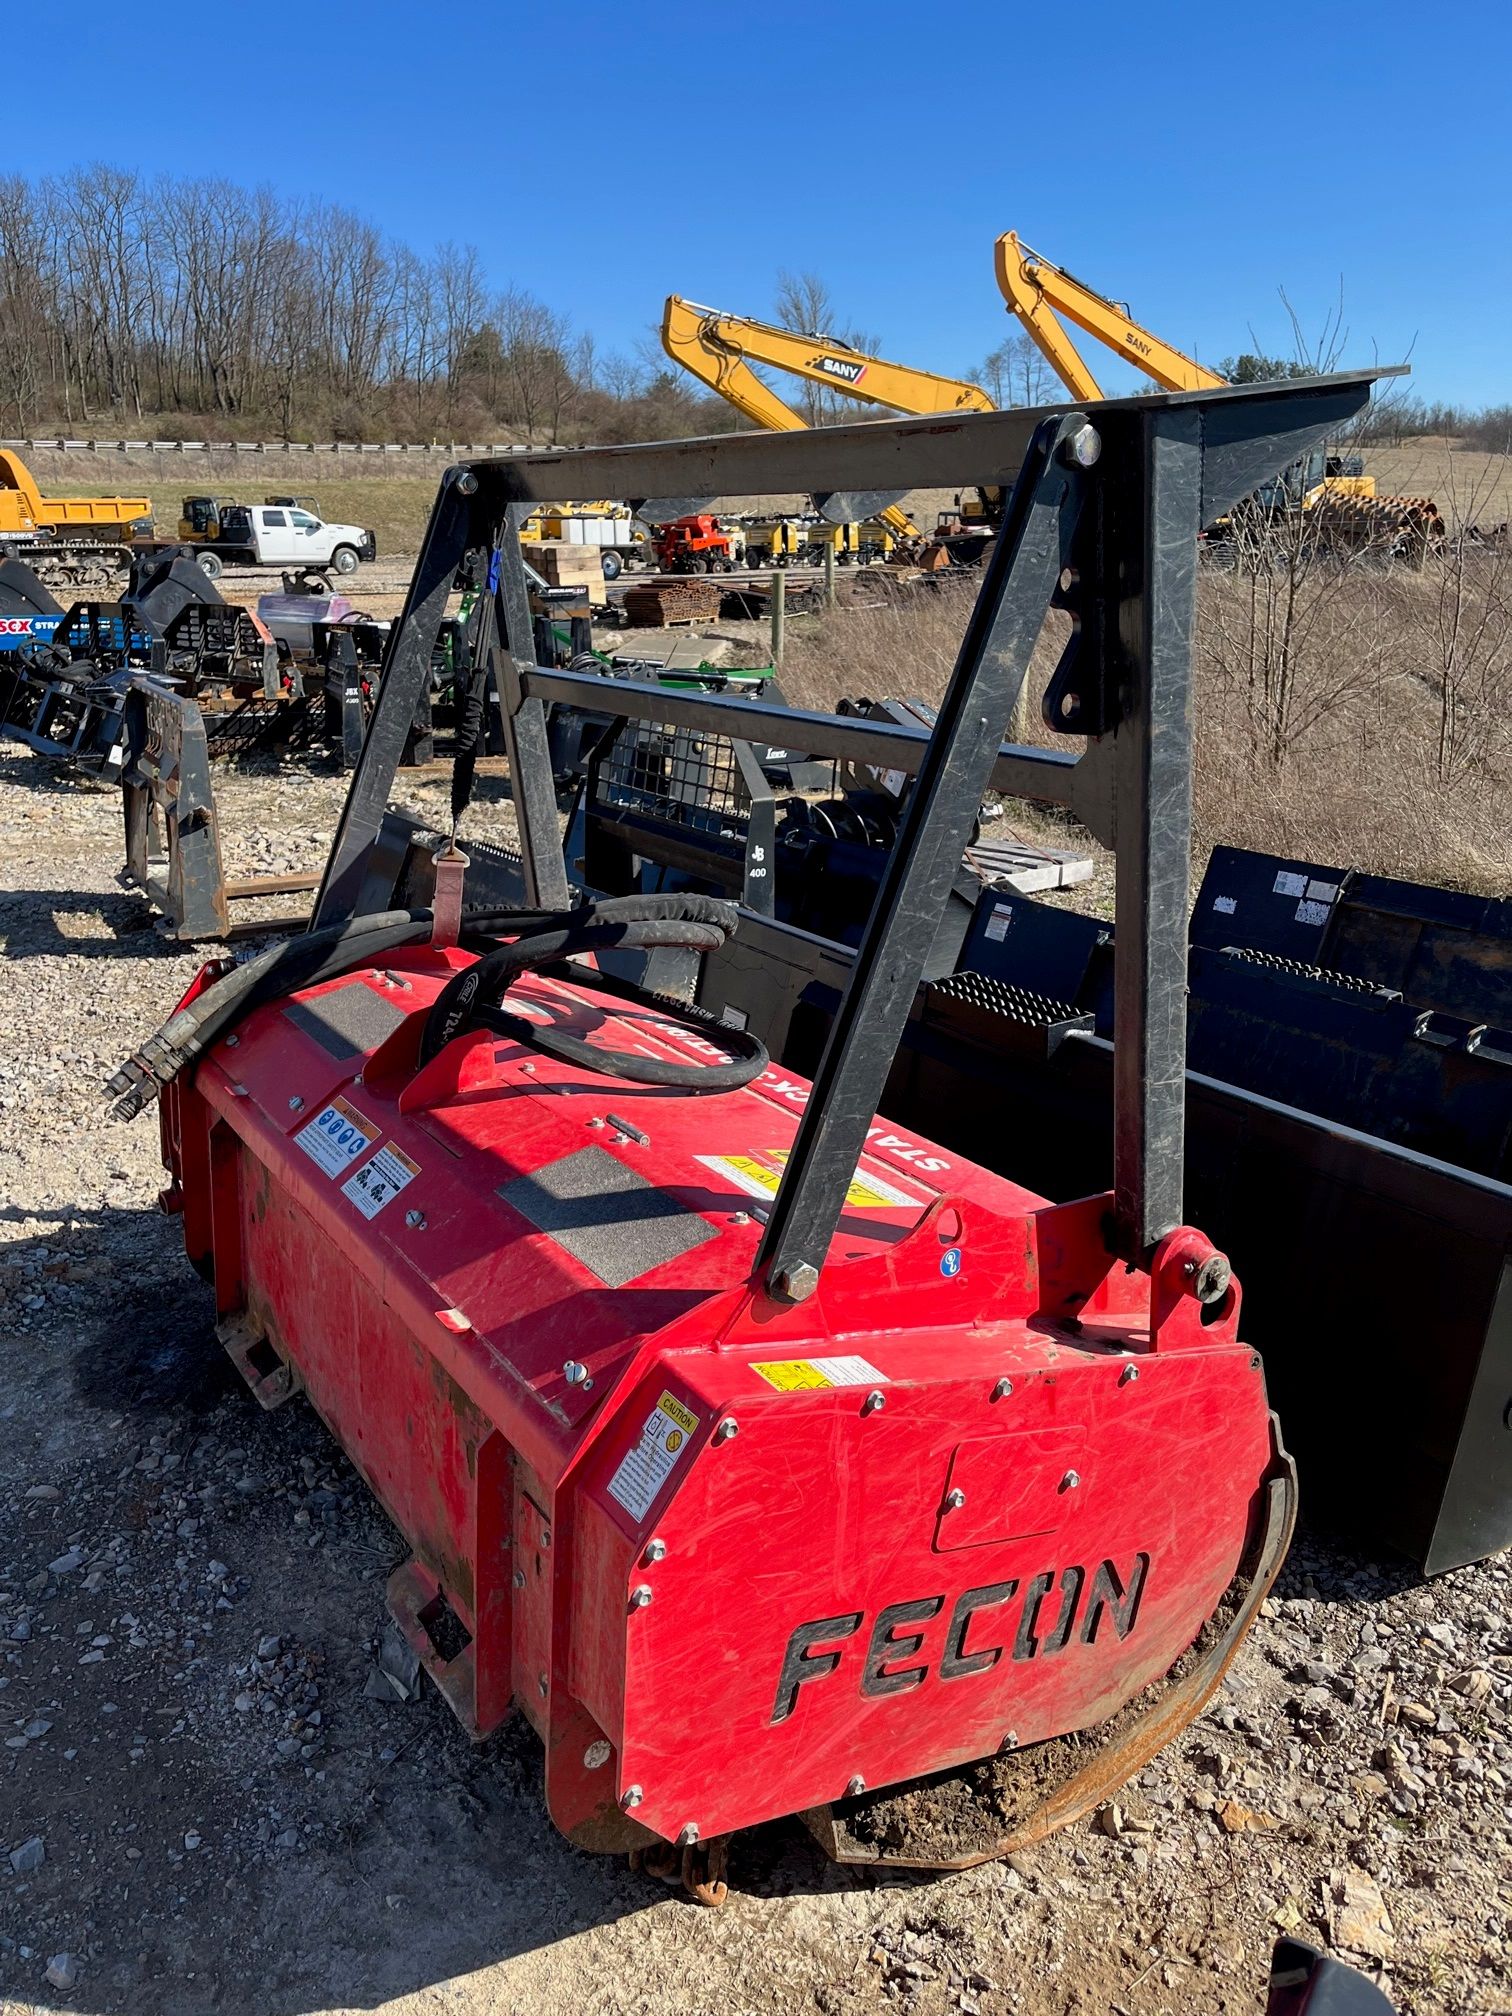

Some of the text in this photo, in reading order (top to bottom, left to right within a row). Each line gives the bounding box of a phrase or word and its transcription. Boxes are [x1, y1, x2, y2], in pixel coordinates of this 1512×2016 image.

[1125, 332, 1152, 356] SANY
[823, 358, 859, 379] SANY
[0, 619, 59, 633] SCX STRA
[751, 844, 765, 862] JB
[749, 867, 767, 878] 400
[663, 1397, 694, 1429] CAUTION
[770, 1551, 1151, 1728] FECON
